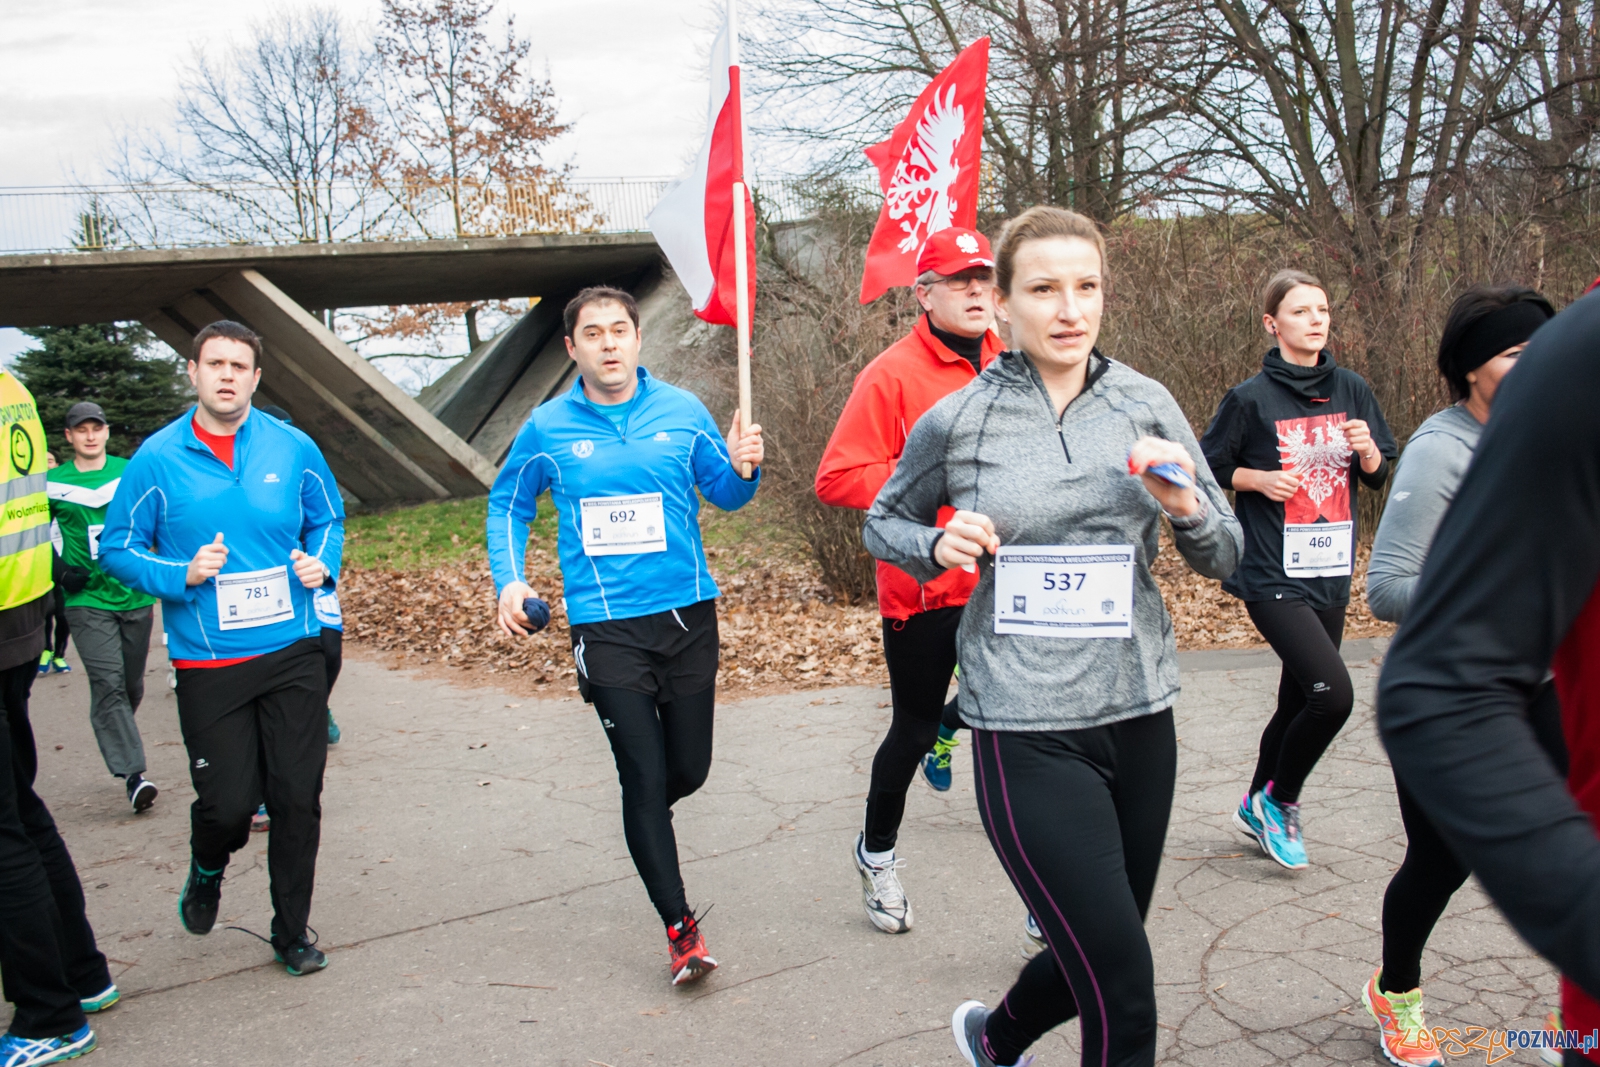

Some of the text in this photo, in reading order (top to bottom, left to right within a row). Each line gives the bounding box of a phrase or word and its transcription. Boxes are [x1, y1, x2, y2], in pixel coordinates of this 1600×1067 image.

[609, 509, 636, 523] 692
[1309, 536, 1332, 548] 460
[1065, 554, 1128, 563] WIELKOPOLSKIEGO
[1043, 572, 1086, 591] 537
[245, 586, 270, 599] 781
